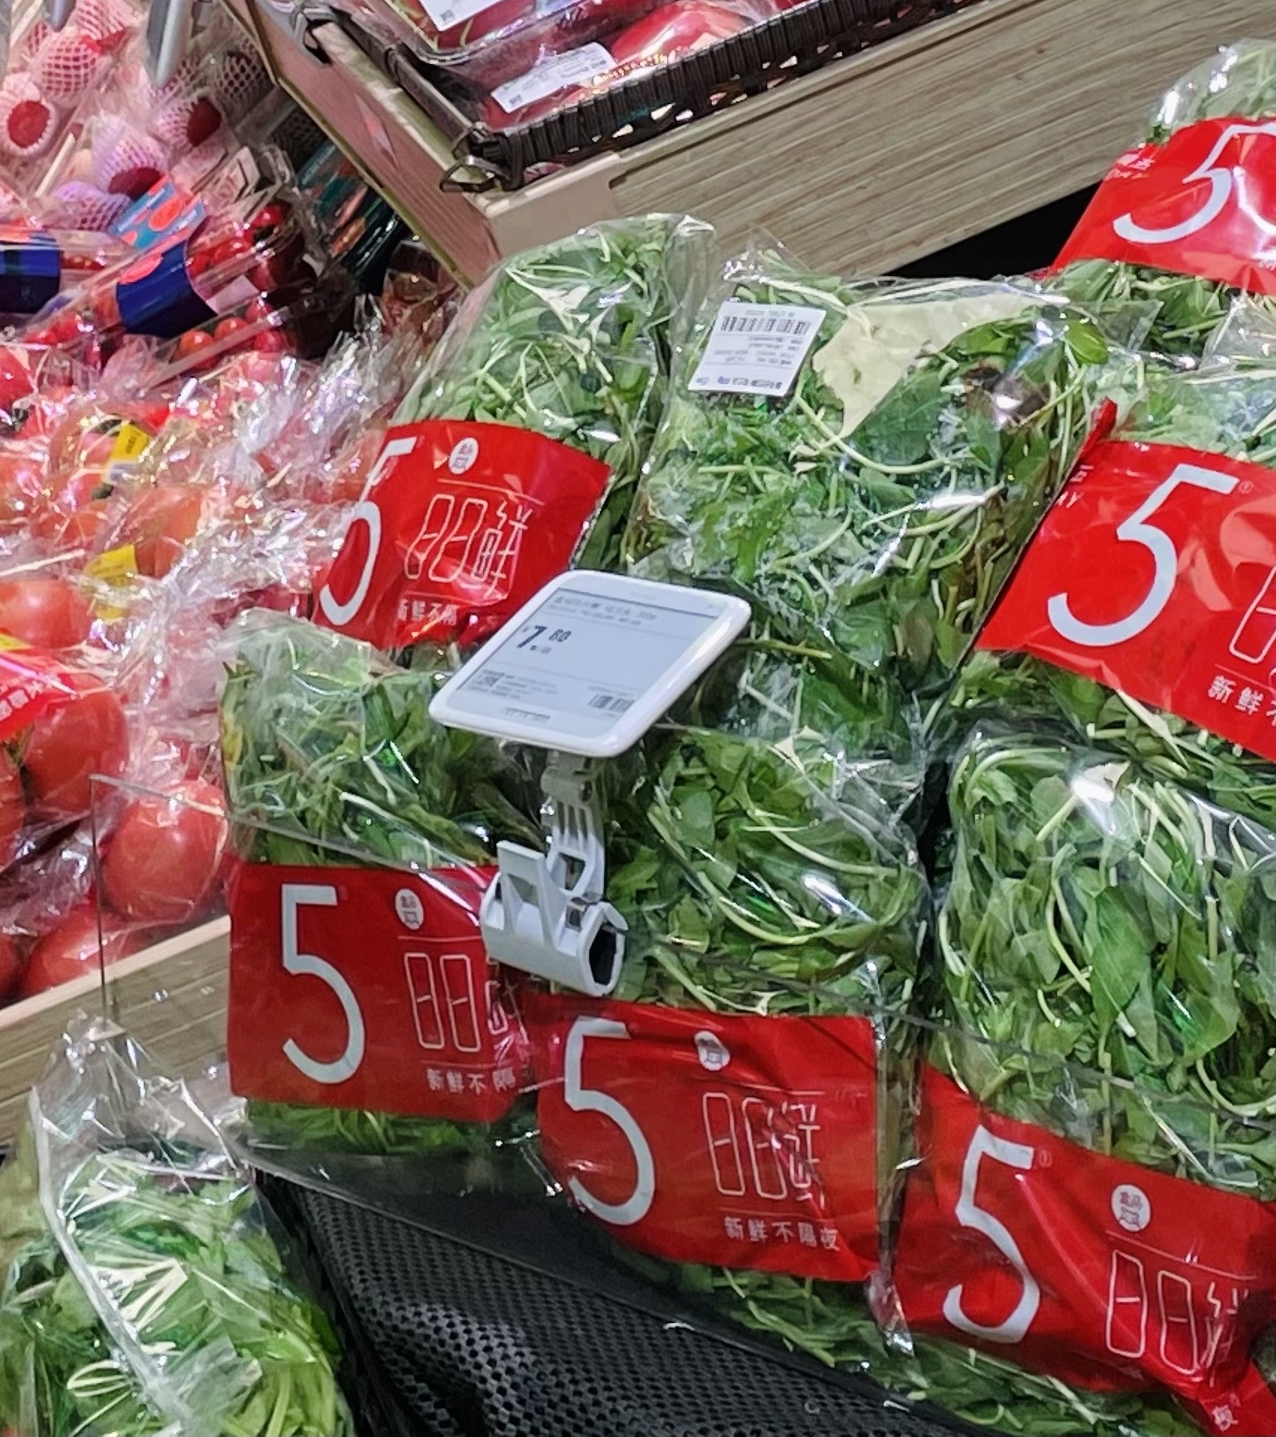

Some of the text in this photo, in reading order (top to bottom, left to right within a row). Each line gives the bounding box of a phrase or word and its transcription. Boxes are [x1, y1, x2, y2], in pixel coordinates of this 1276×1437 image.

[319, 435, 418, 626] 5
[404, 493, 533, 599] 日日鲜
[1047, 462, 1240, 647] 5
[281, 883, 366, 1085] 5
[564, 1015, 655, 1226] 5
[724, 1215, 841, 1252] 新鲜不隔夜
[942, 1124, 1041, 1344] 5
